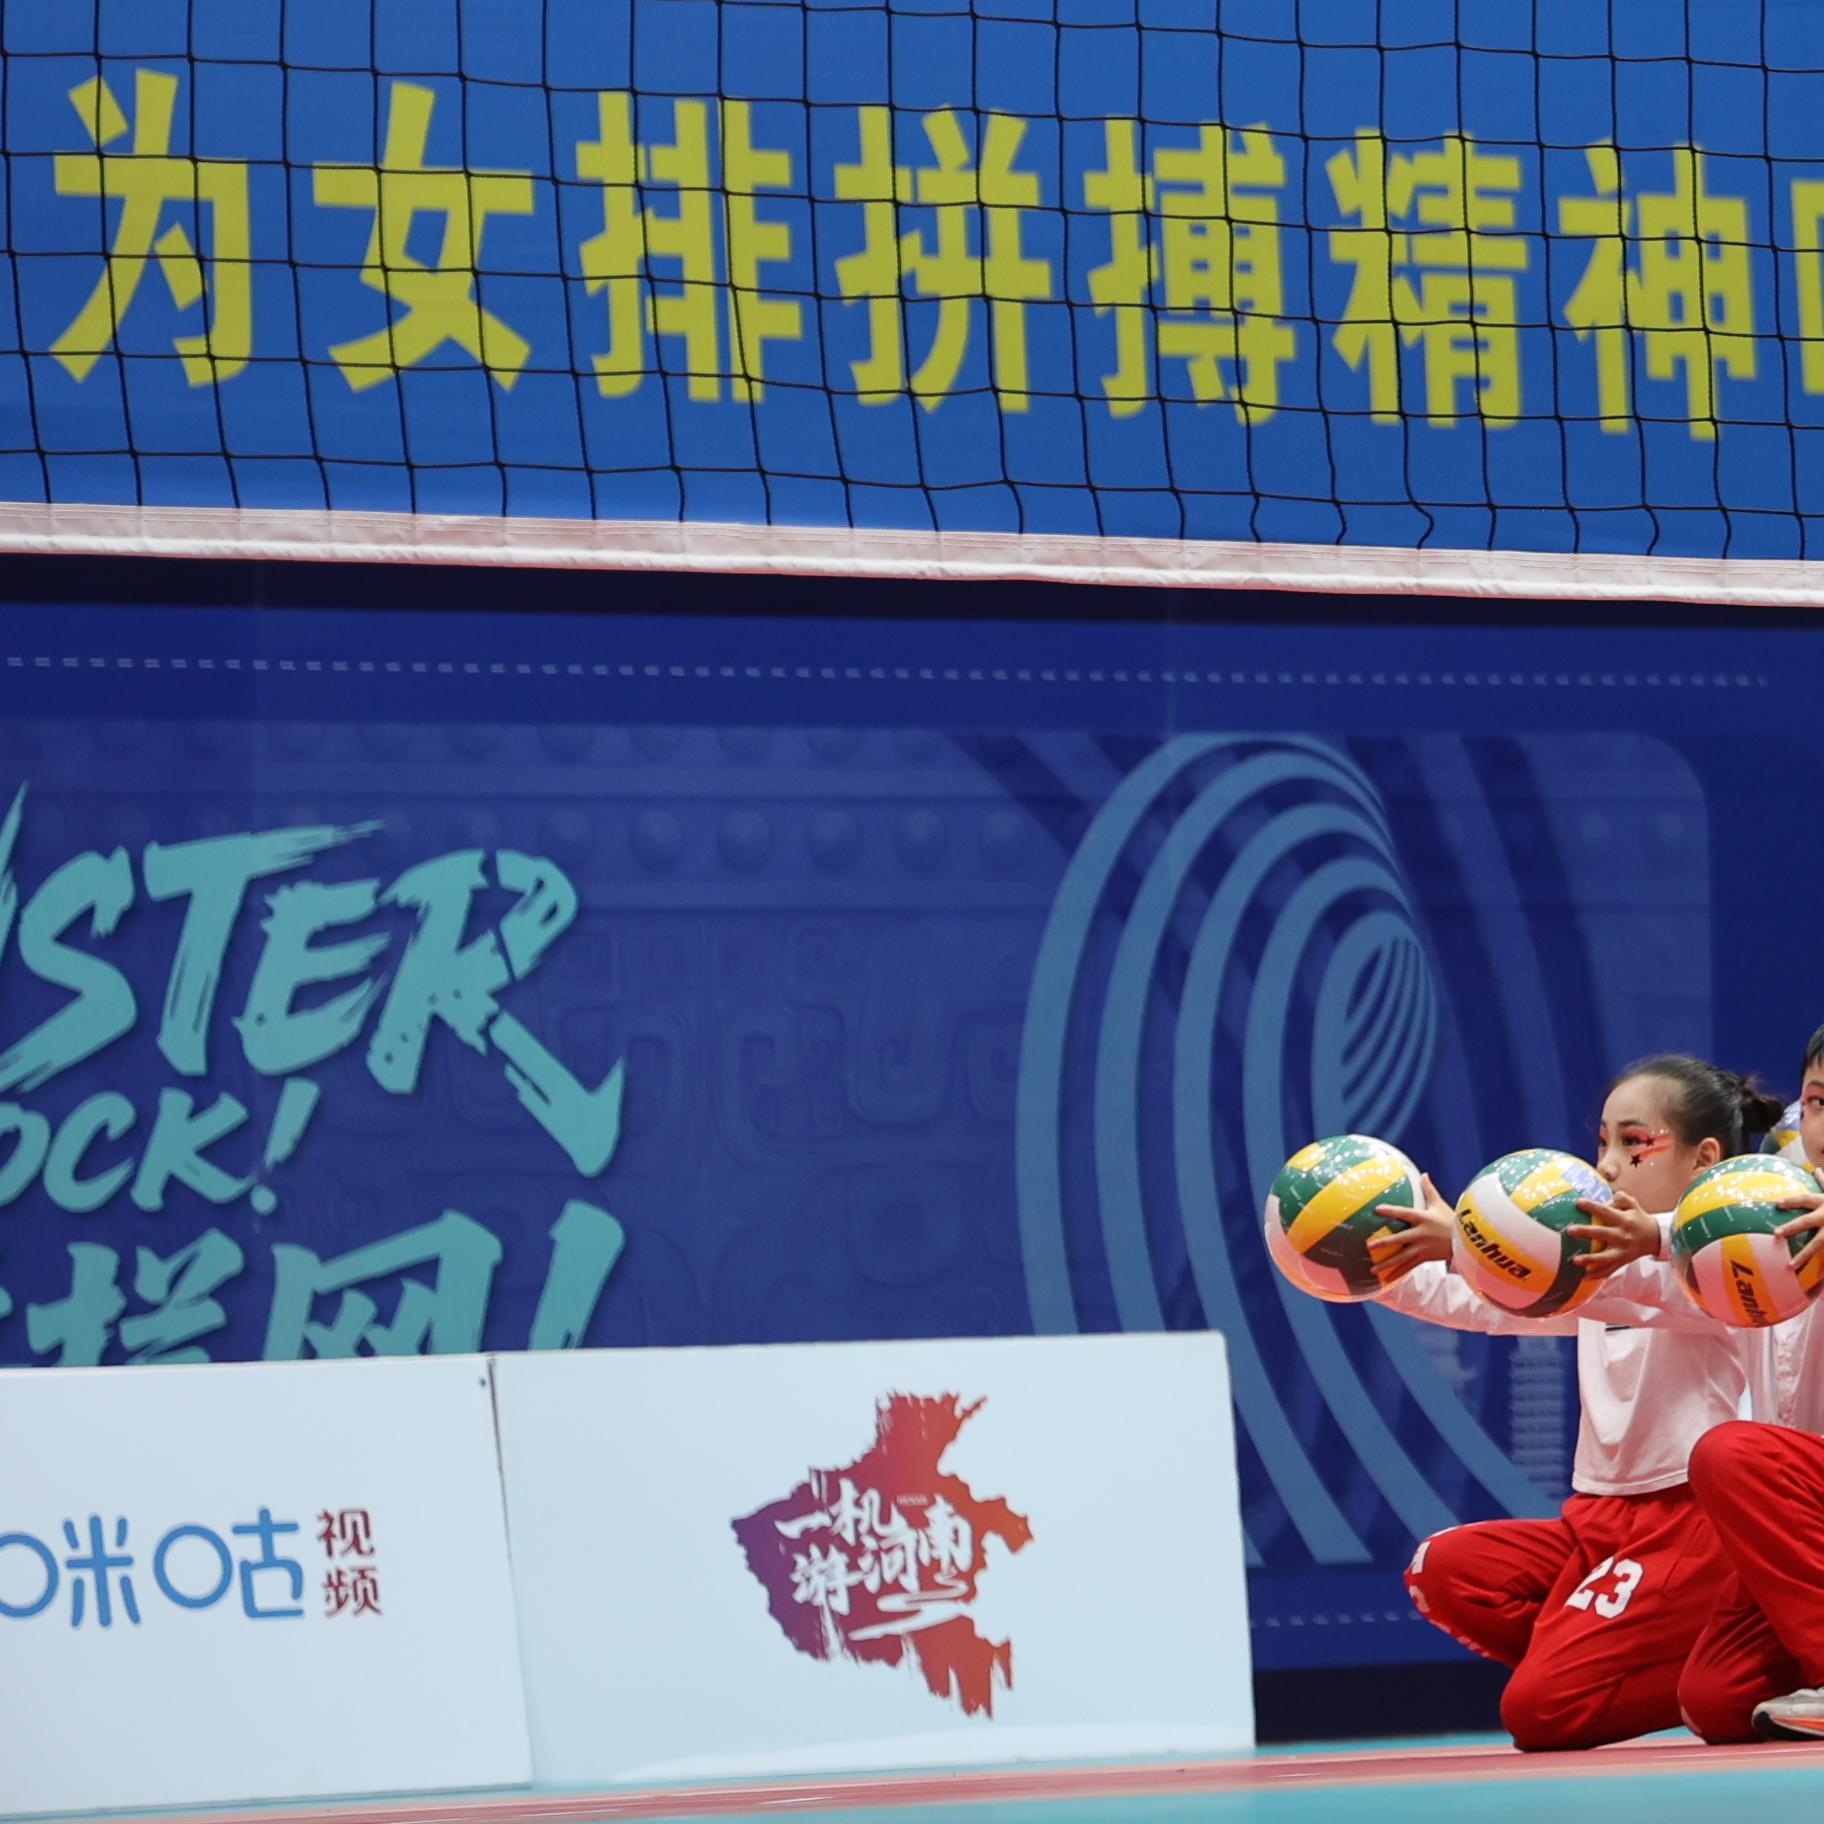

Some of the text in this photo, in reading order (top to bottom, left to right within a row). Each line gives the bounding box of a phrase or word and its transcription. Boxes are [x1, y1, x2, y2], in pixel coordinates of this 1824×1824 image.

[0, 780, 624, 1177] STER
[0, 1198, 626, 1366] 拦网!
[1457, 1207, 1533, 1282] Lanhua
[316, 1507, 384, 1618] 视频
[1564, 1555, 1644, 1620] 23
